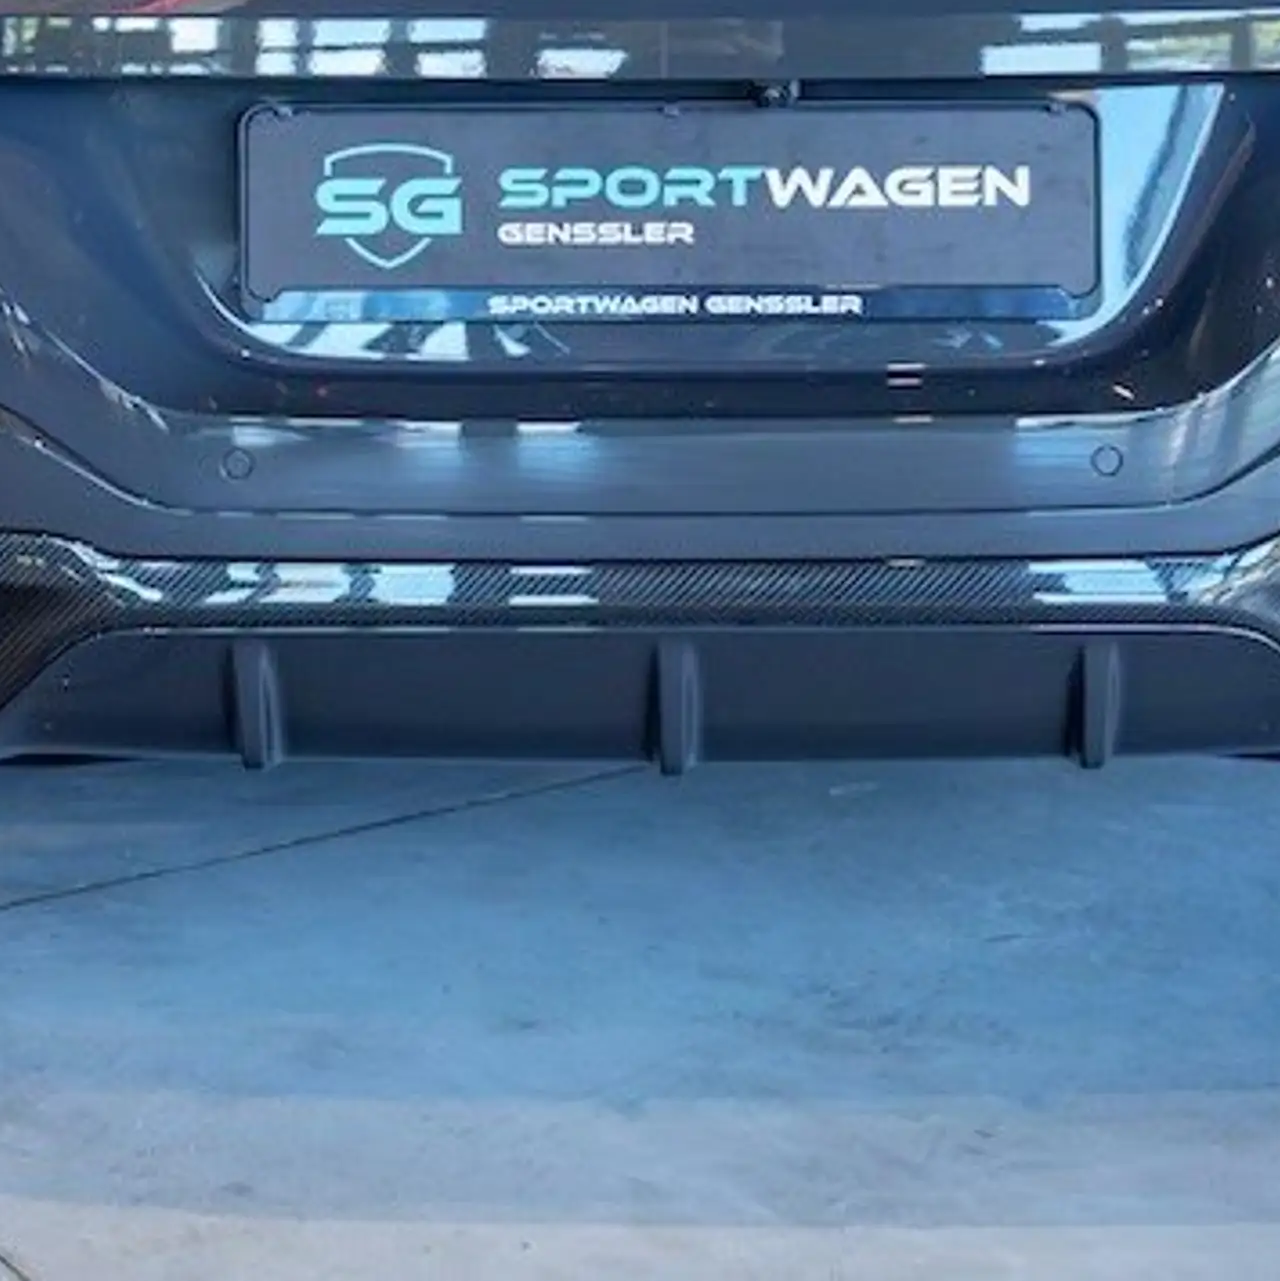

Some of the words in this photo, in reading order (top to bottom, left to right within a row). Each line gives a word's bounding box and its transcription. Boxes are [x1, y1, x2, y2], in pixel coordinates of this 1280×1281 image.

[498, 166, 1031, 208] SPORTWAGEN
[315, 177, 463, 236] SG
[497, 221, 696, 245] GENSSLER
[488, 295, 698, 315] SPORTWAGEN
[704, 295, 863, 315] GENSSLER
